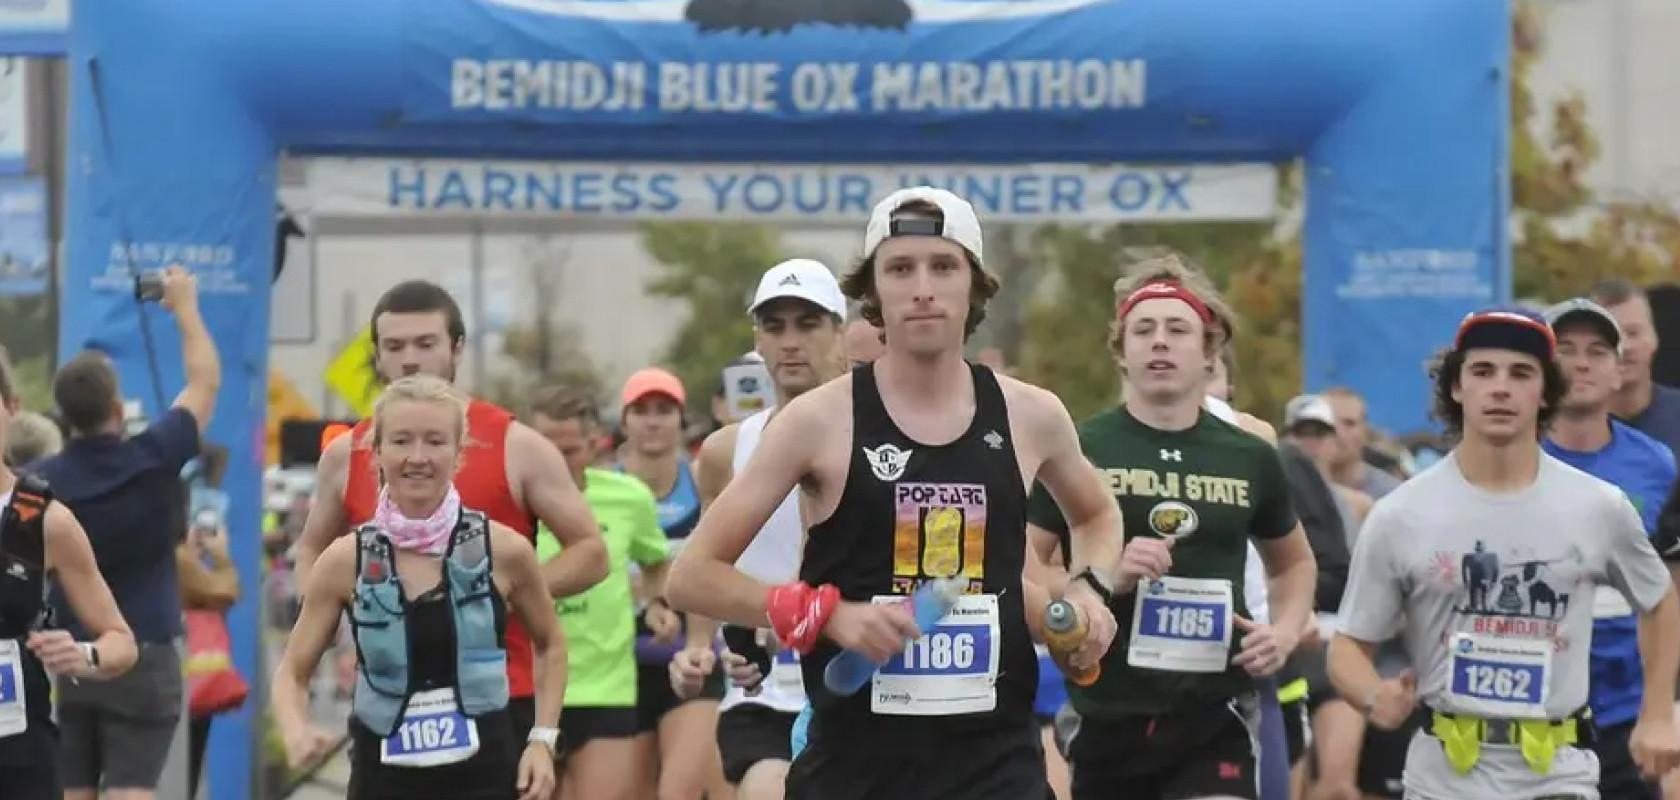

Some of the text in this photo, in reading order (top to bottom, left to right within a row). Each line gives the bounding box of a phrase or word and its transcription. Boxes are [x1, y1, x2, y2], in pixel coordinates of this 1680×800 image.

[452, 60, 1147, 112] BEMIDJI BLUE OX MARATHON
[388, 168, 680, 214] HARNESS
[705, 172, 872, 214] YOUR
[1109, 172, 1192, 212] OX
[899, 486, 935, 503] POP
[1185, 474, 1250, 508] STATE
[1156, 605, 1214, 637] 1185
[903, 632, 974, 669] 1186
[1465, 665, 1531, 698] 1262
[398, 716, 456, 751] 1162
